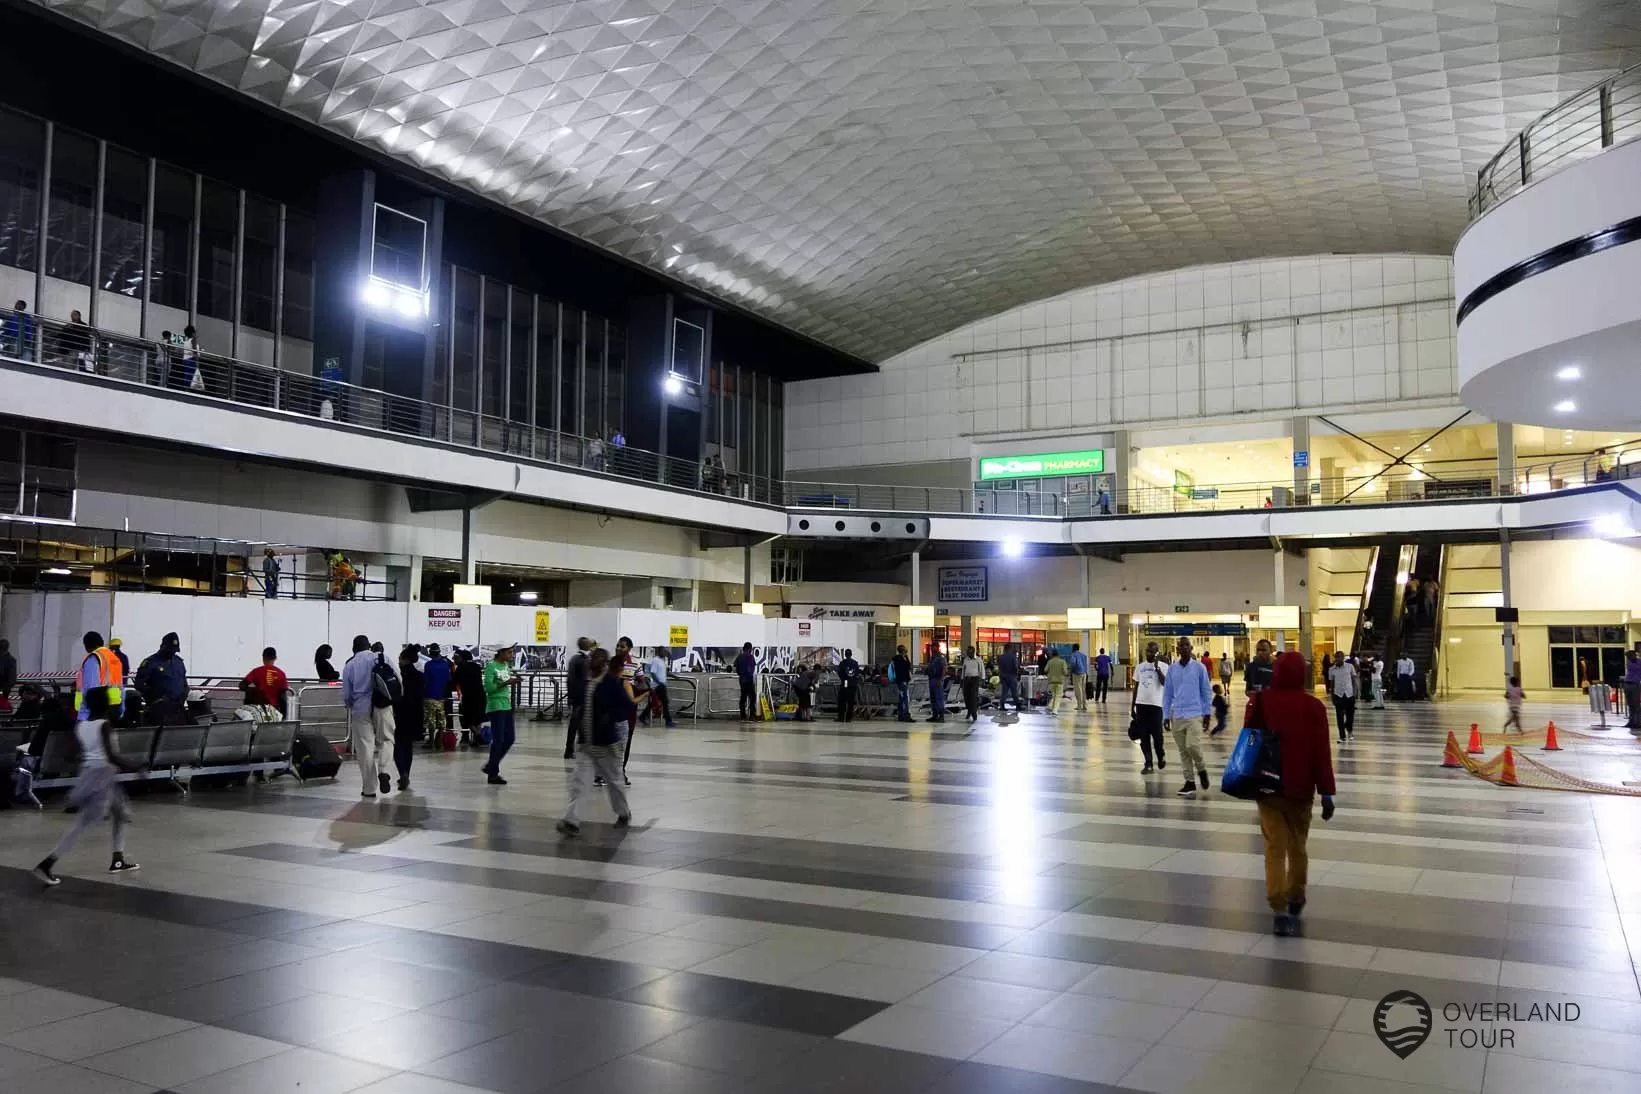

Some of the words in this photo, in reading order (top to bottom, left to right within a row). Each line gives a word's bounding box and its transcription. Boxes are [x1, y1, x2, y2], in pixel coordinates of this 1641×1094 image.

[1043, 457, 1100, 472] PHARMACY
[429, 620, 446, 628] KEEP
[447, 620, 460, 628] OUT
